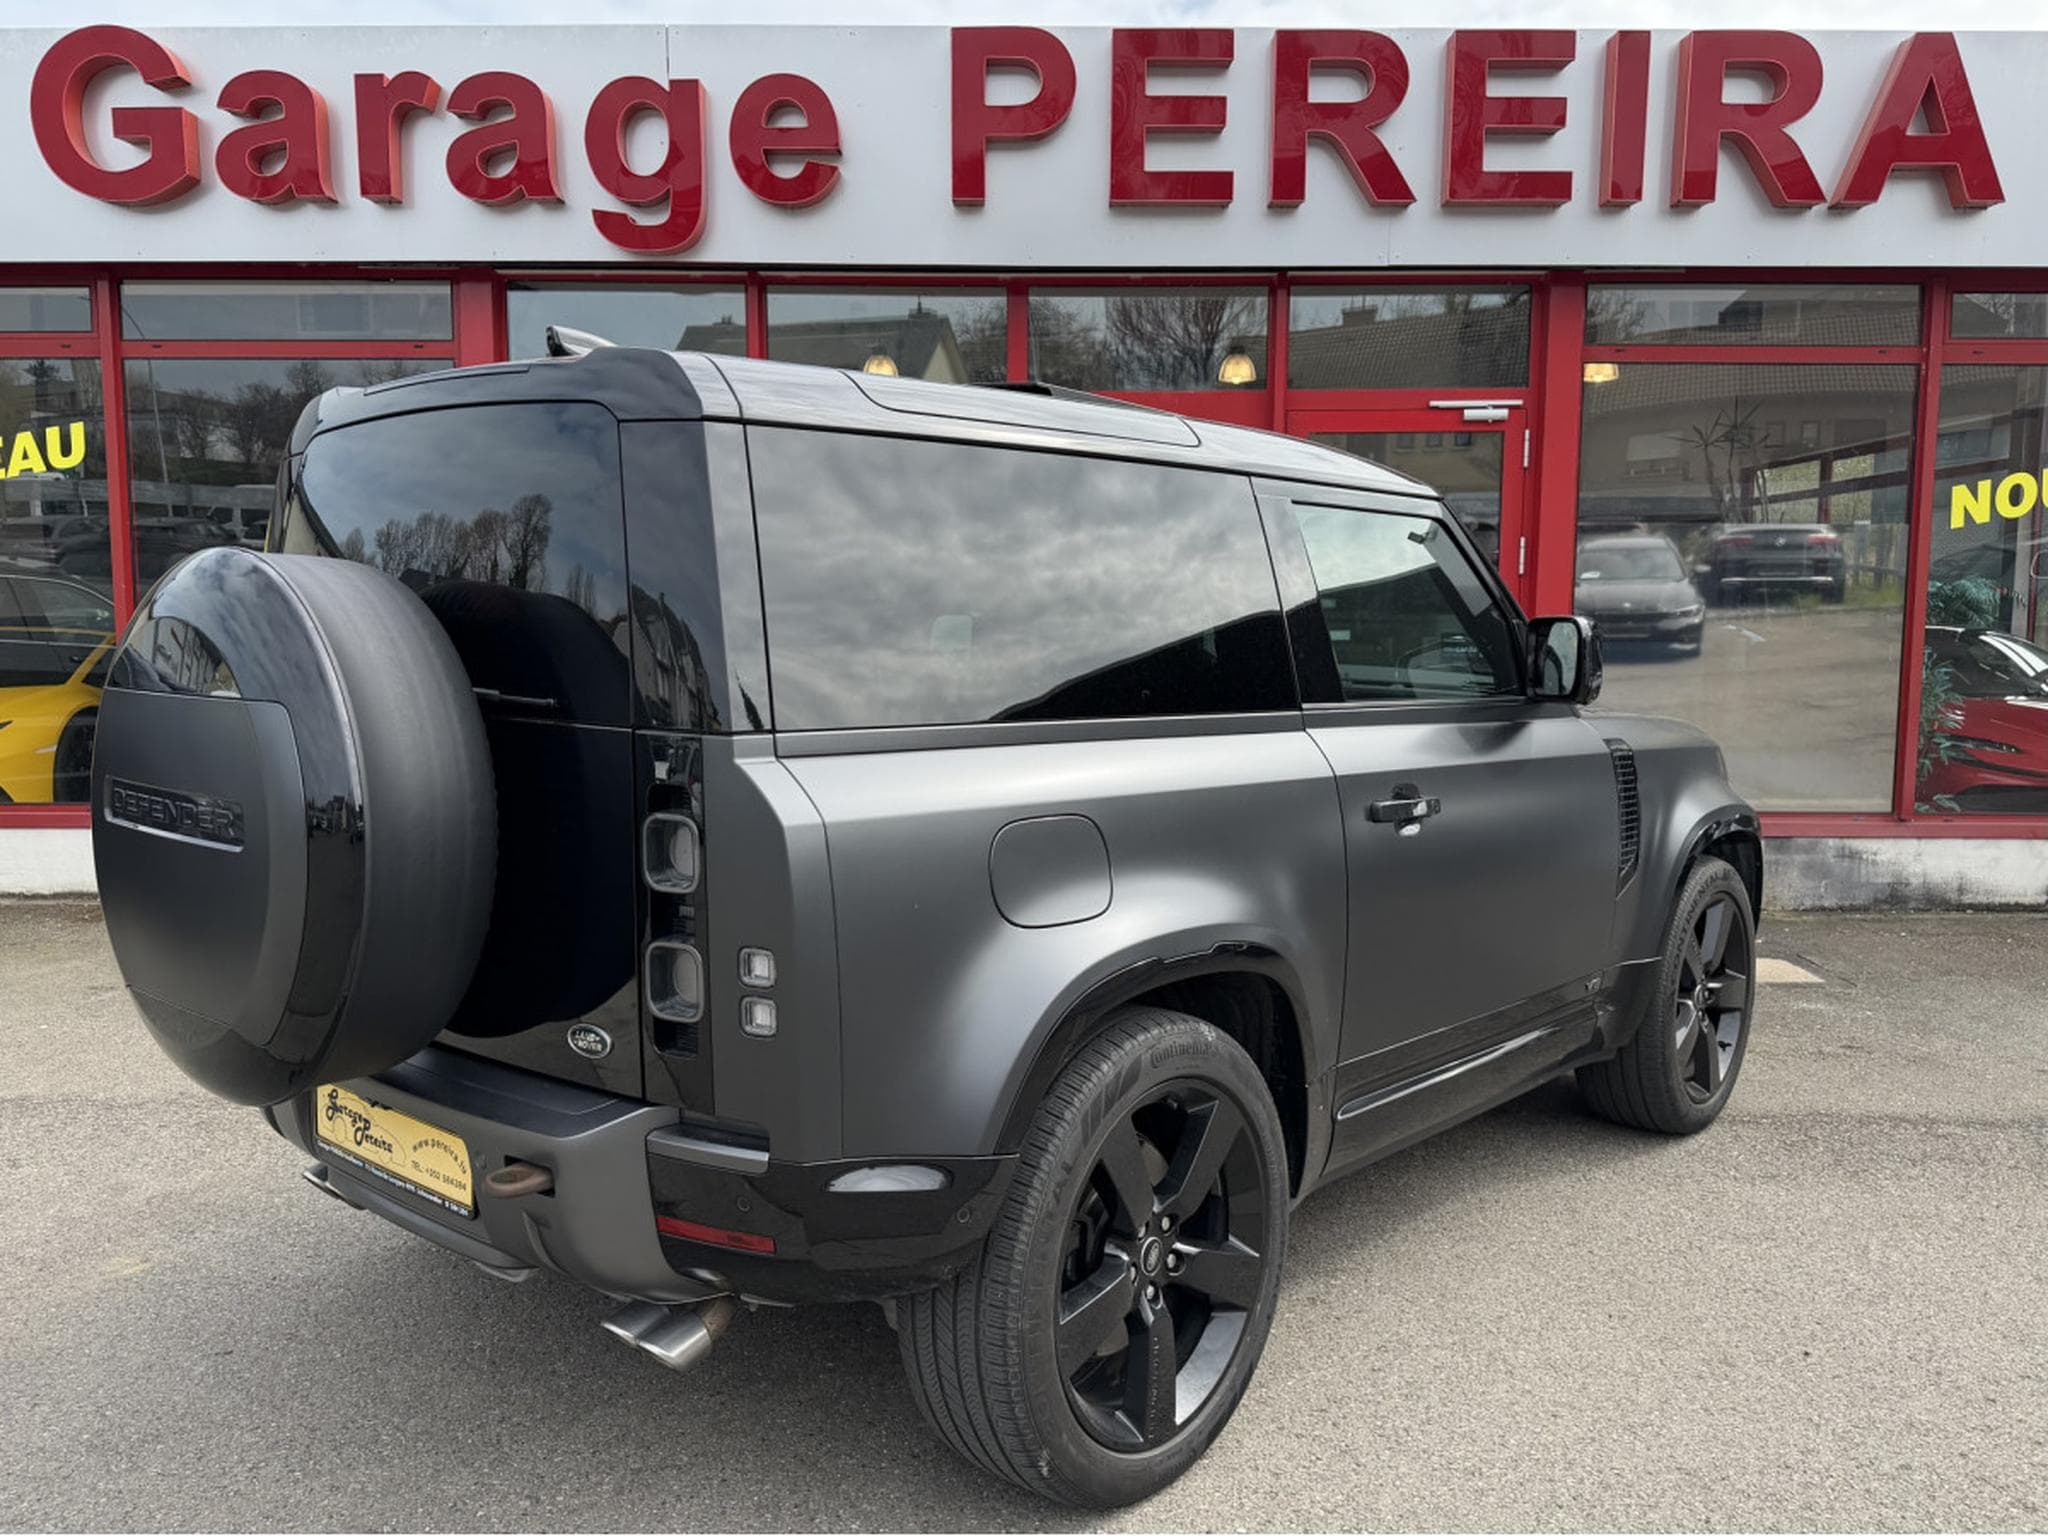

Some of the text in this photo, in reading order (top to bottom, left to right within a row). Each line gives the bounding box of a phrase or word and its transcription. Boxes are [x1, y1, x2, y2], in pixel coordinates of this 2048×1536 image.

[30, 24, 2006, 254] Garage PEREIRA
[0, 421, 86, 479] AU
[1950, 468, 2048, 529] NO
[112, 786, 236, 837] DEFENDER
